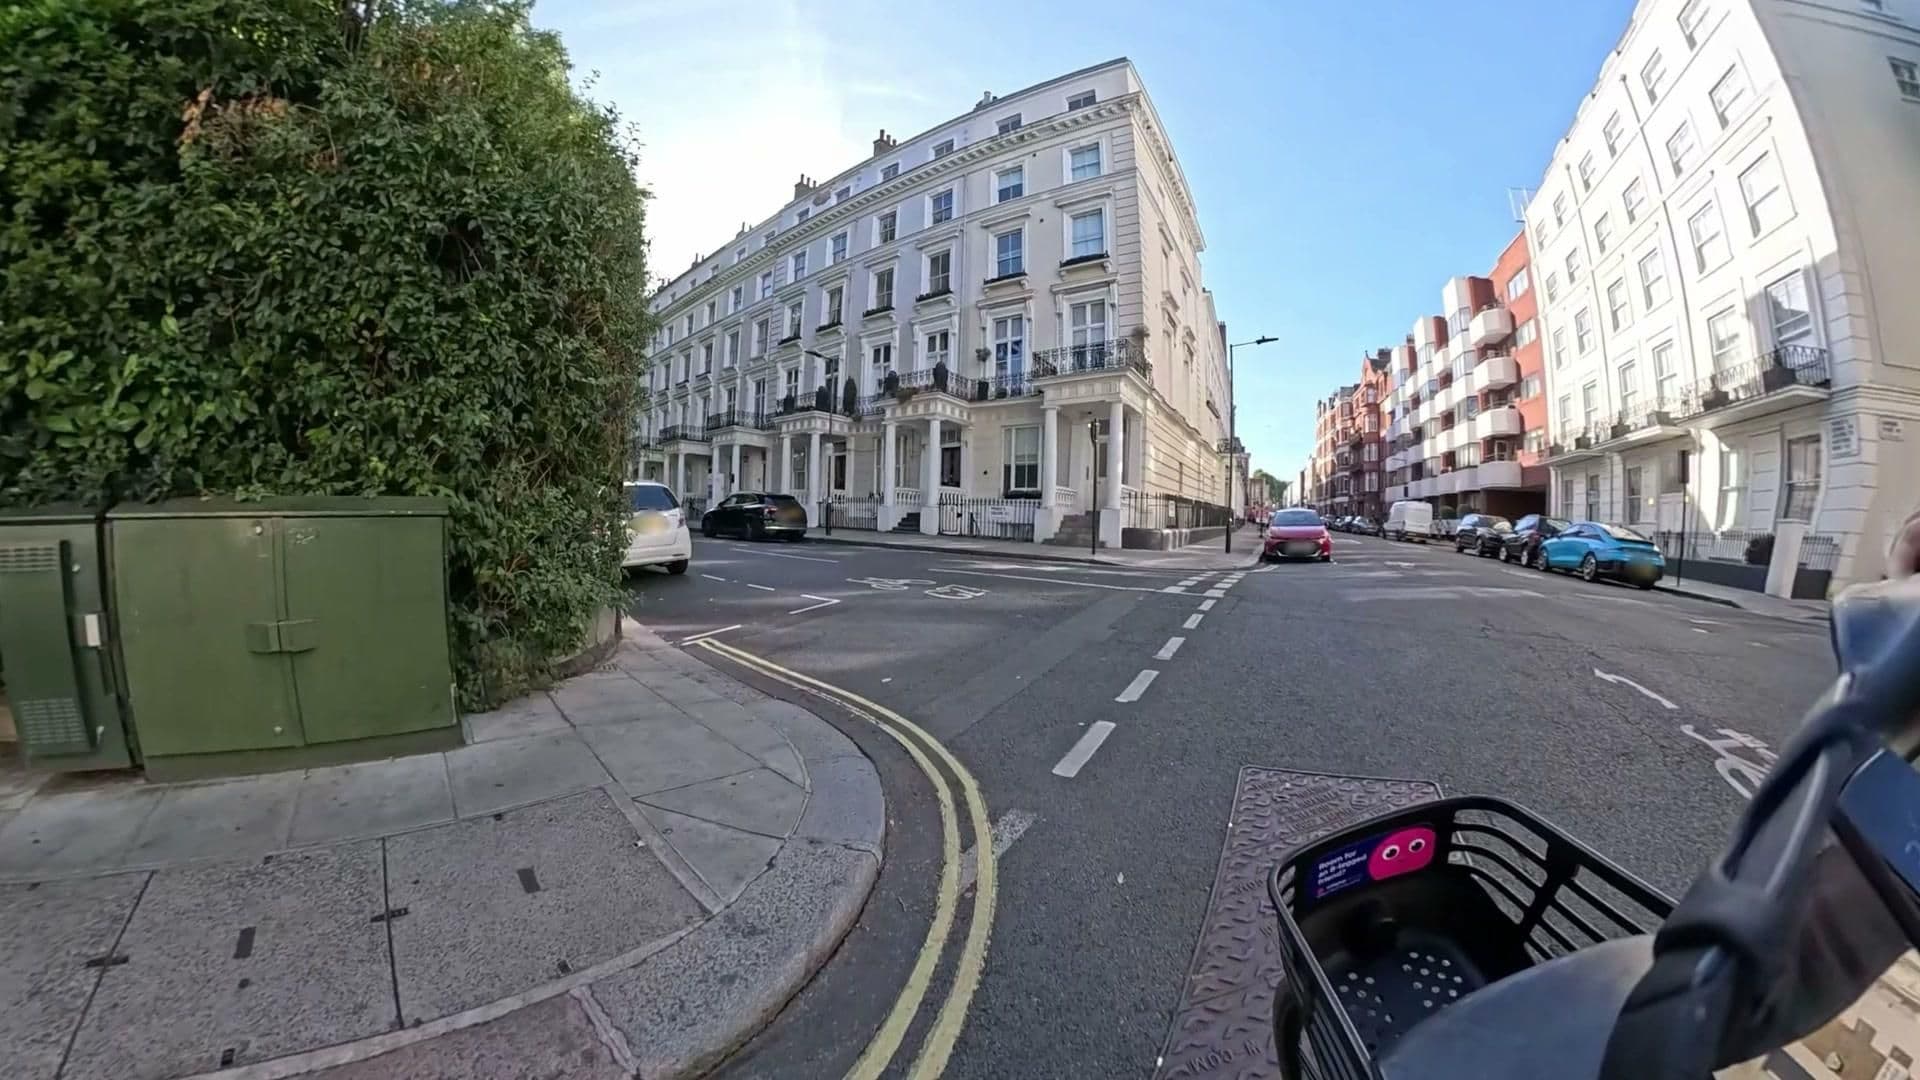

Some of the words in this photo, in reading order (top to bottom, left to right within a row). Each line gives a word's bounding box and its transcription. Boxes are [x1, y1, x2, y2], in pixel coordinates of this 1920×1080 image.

[1319, 856, 1343, 870] Room
[1344, 850, 1357, 860] for
[1318, 869, 1346, 885] friend?
